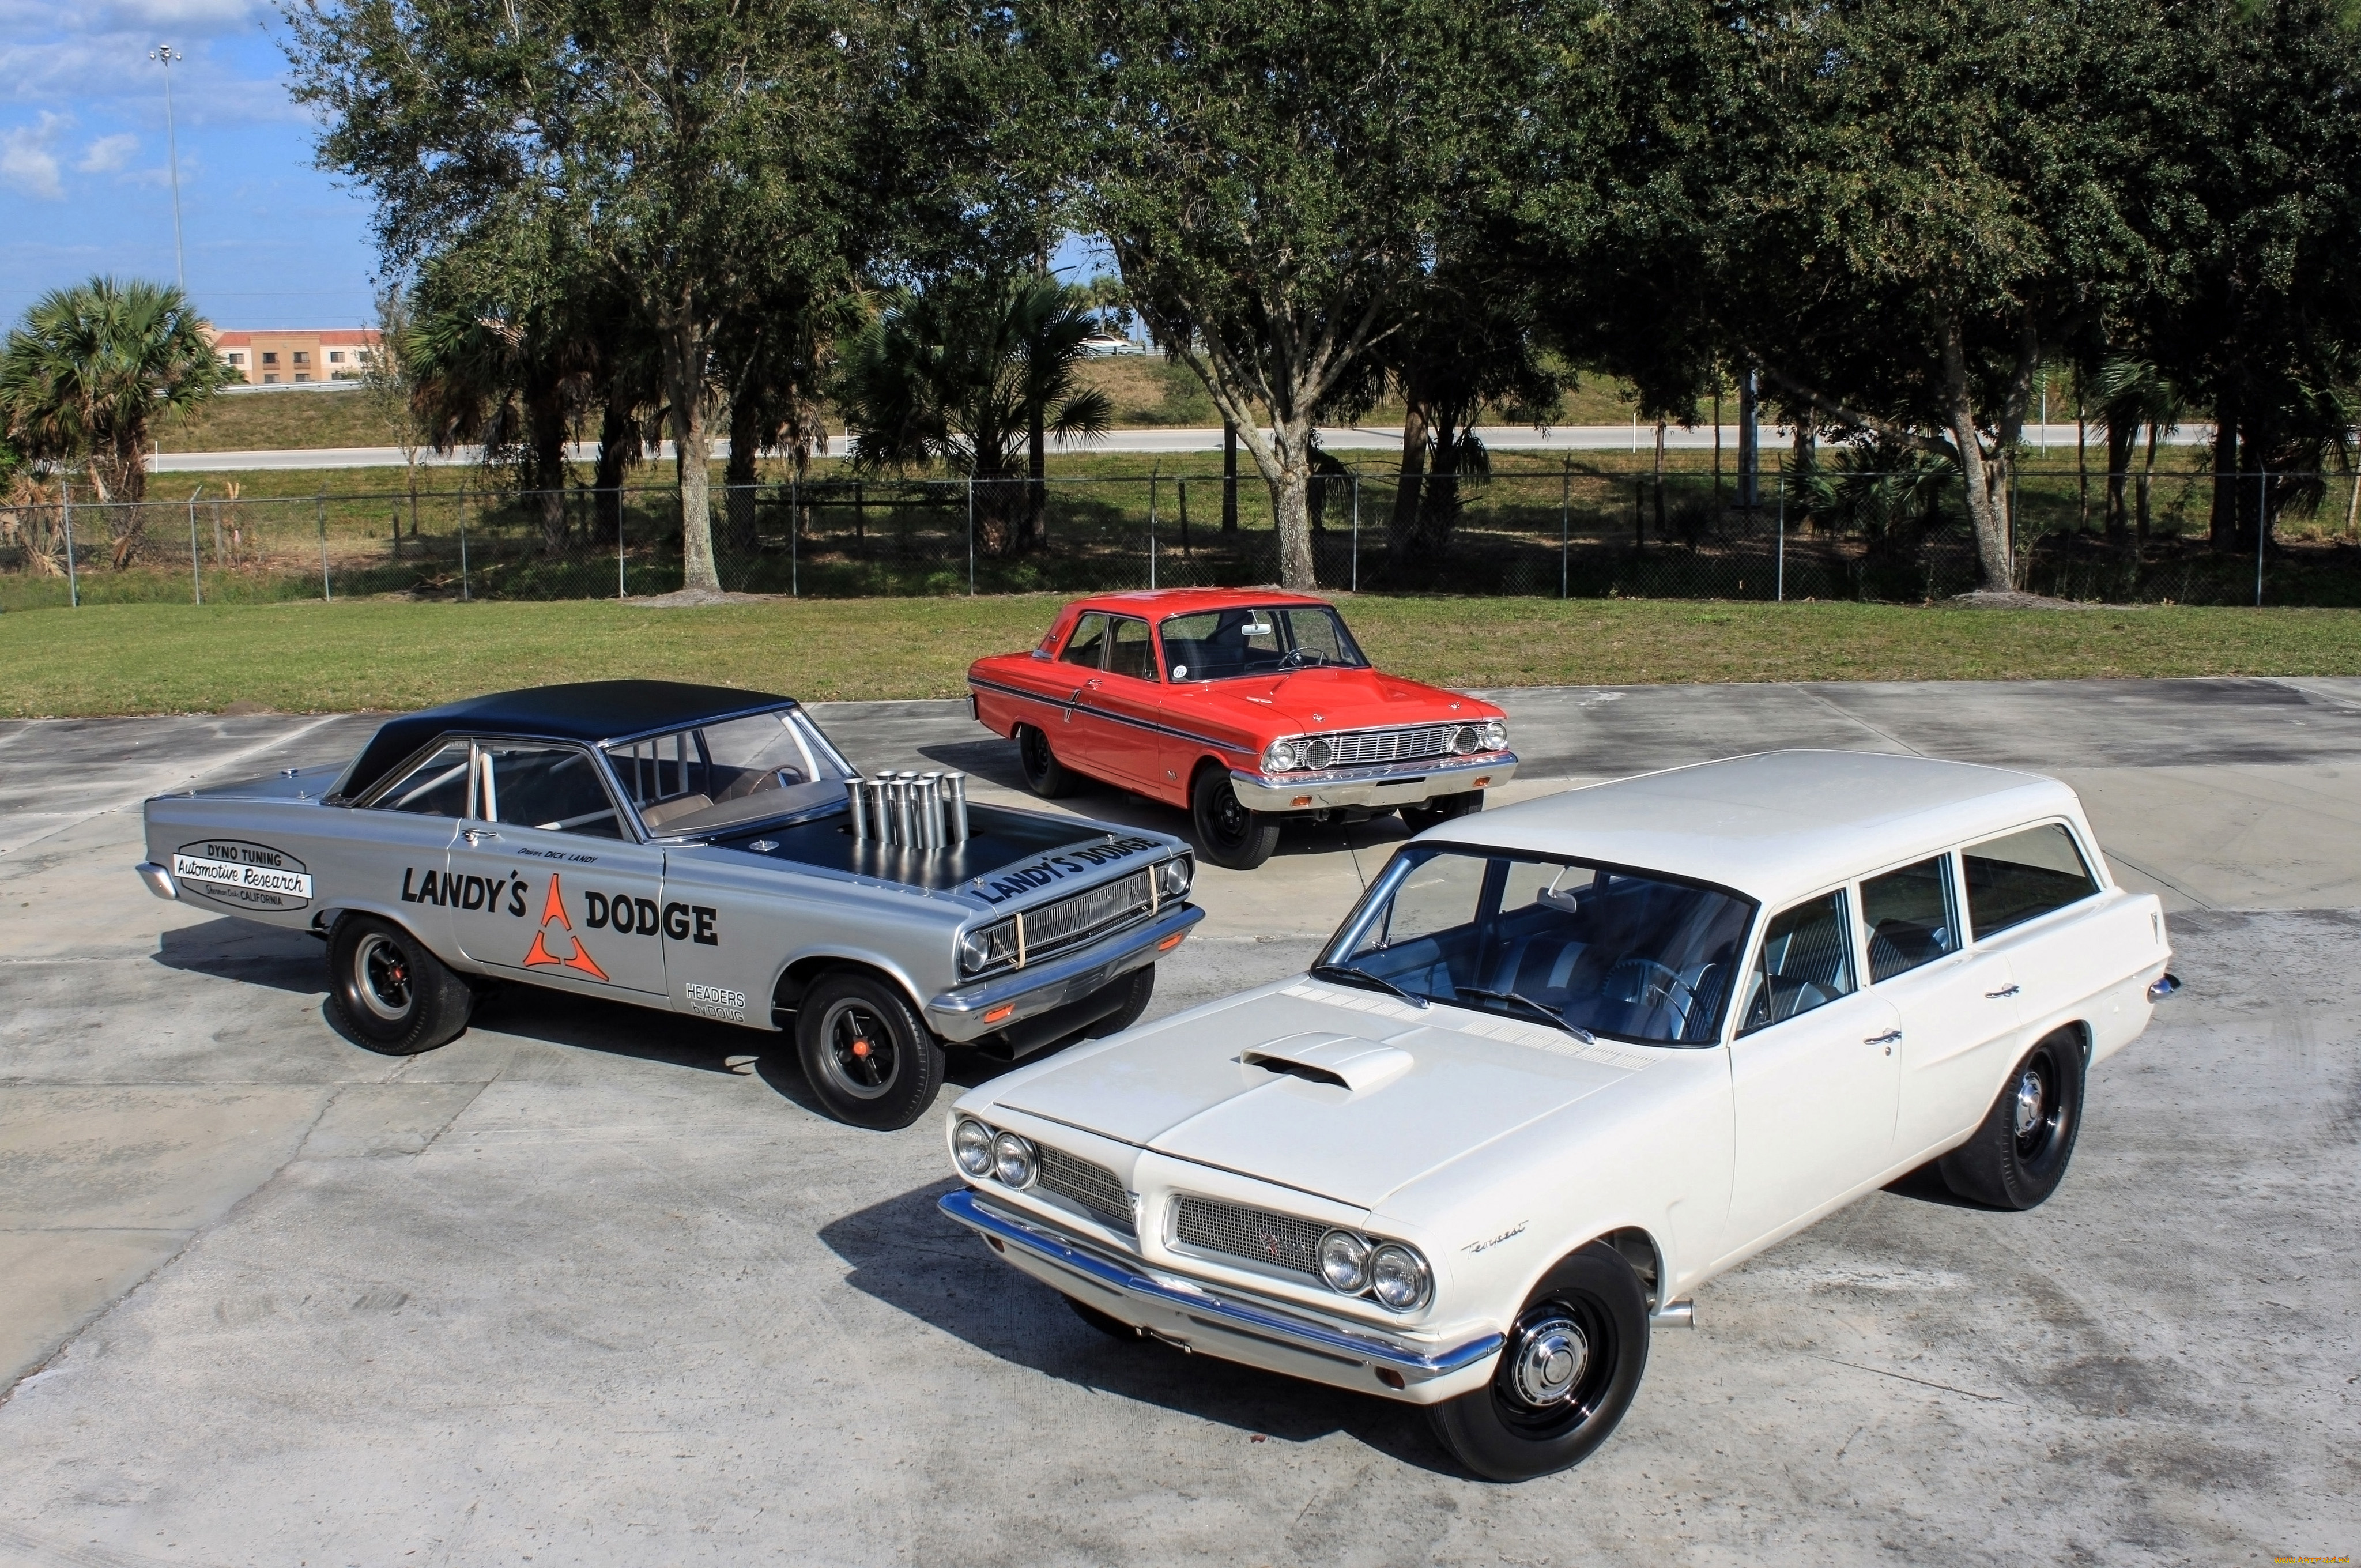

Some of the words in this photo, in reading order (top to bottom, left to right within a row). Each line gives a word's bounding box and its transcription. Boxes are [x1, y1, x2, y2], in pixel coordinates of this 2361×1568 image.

[208, 844, 238, 860] DYNO
[242, 849, 282, 867] TUNING
[544, 851, 567, 860] DICK
[568, 854, 598, 864] LANDY
[178, 858, 239, 882] Automotive
[244, 868, 304, 893] Research
[970, 857, 1084, 905] LANDY'S
[1068, 836, 1164, 866] DODGE
[240, 890, 284, 906] CALIFORNIA
[401, 867, 529, 918] LANDY'S
[585, 891, 719, 947] DODGE
[686, 983, 745, 1008] HEADERS
[691, 1001, 706, 1017] by
[706, 1004, 745, 1023] DOUG
